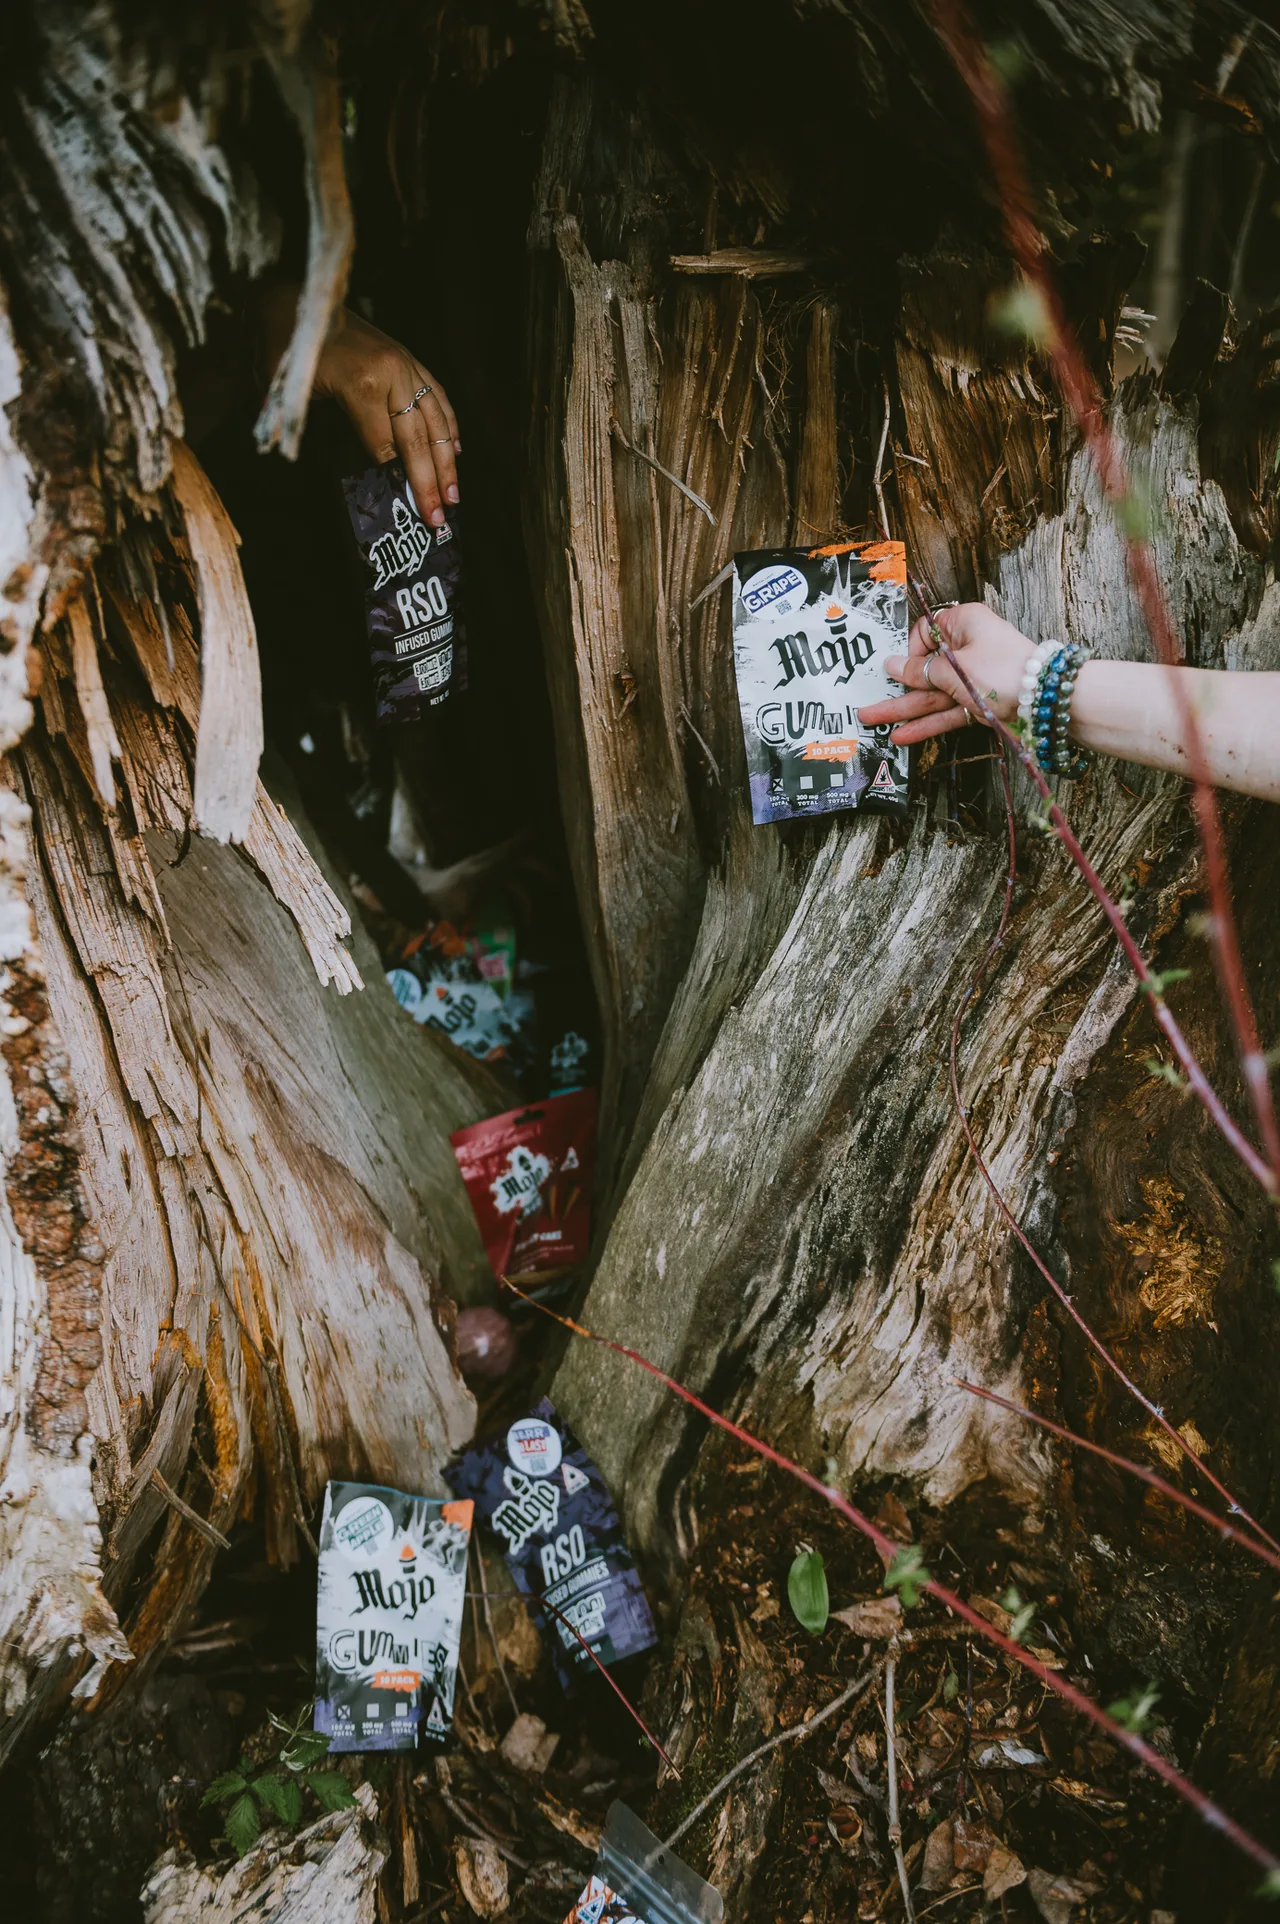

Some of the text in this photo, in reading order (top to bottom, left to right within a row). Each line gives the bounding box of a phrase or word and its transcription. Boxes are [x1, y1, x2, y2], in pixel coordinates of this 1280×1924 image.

[370, 523, 431, 590] Mojo
[396, 576, 448, 629] RSO
[745, 573, 801, 610] GRAPE
[395, 631, 431, 655] INFUSED
[769, 630, 876, 690] Mojo
[812, 745, 851, 756] 10 PACK
[337, 1504, 383, 1541] GREEN
[350, 1519, 385, 1549] APPLE
[494, 1481, 559, 1554] Mojo
[540, 1524, 587, 1586] RSO
[349, 1568, 436, 1620] Mojo
[329, 1629, 447, 1673] GUMMIES
[391, 1675, 415, 1685] PACK
